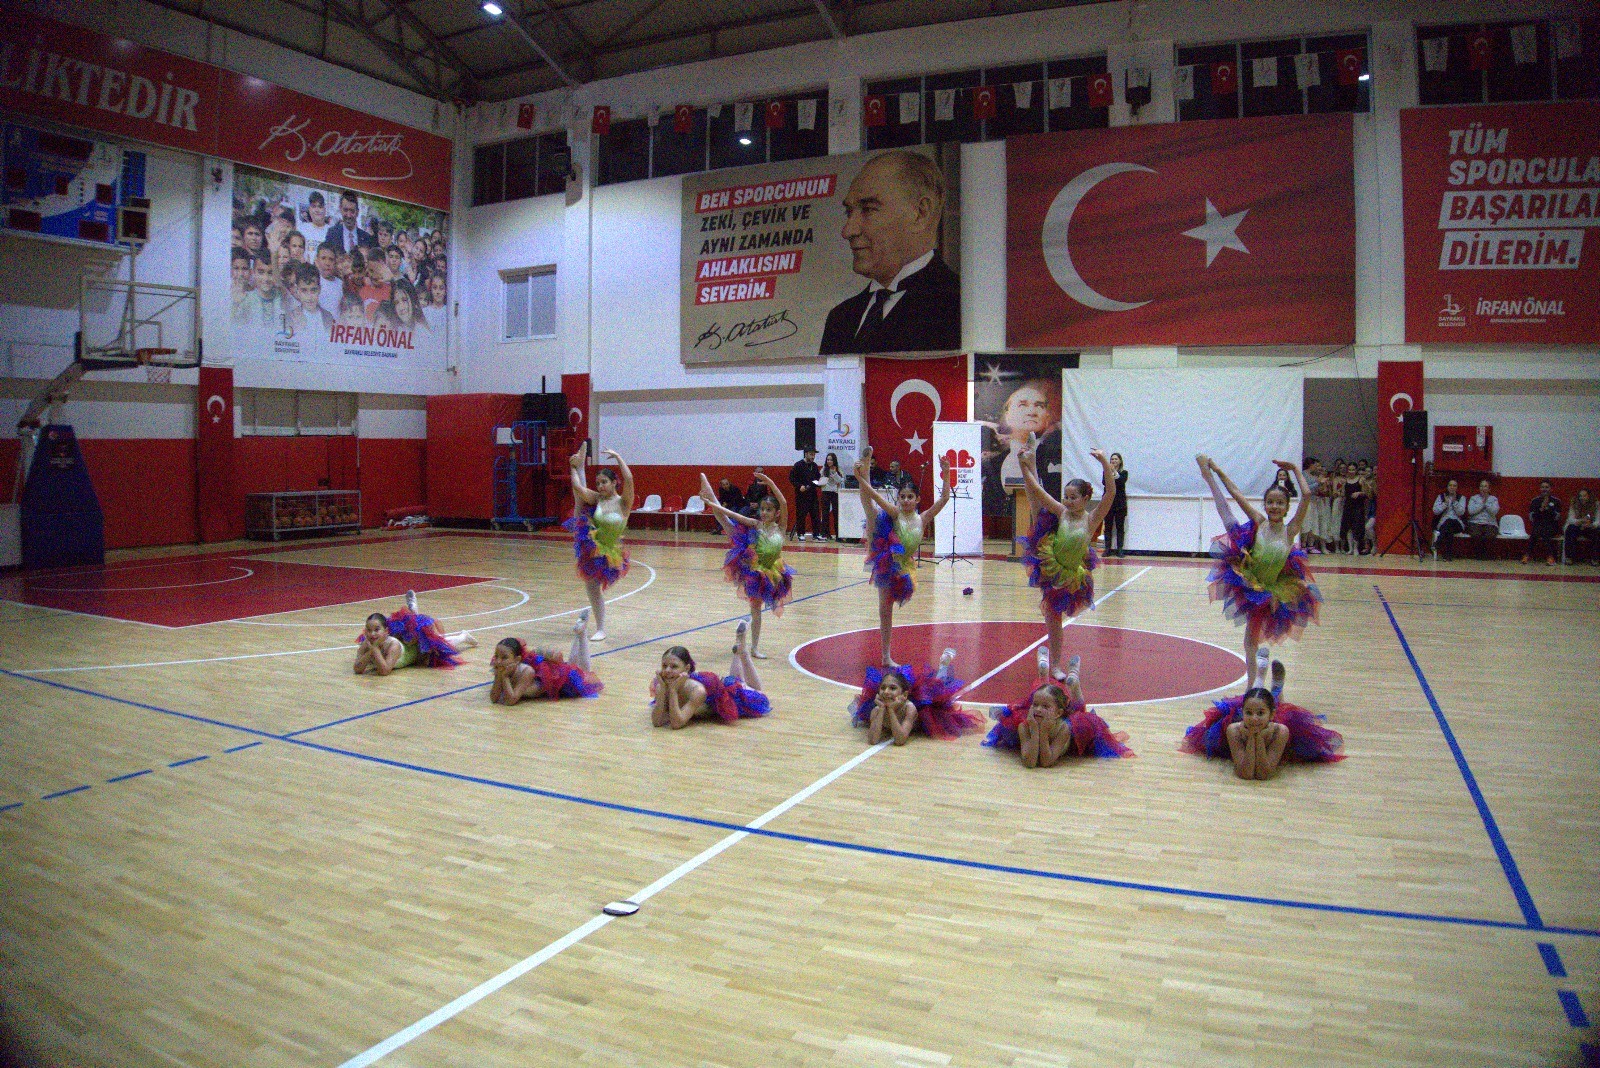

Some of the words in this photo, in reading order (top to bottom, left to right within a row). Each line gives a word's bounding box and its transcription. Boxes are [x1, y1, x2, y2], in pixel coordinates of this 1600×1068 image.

[1448, 121, 1509, 155] TÜM
[699, 190, 730, 210] BEN
[733, 178, 831, 205] SPORCUNUN
[700, 210, 736, 233] ZEKİ,
[741, 204, 788, 230] ÇEVİK
[791, 204, 812, 221] VE
[700, 236, 736, 255] AYNI
[738, 227, 814, 251] ZAMANDA
[1448, 232, 1576, 265] DİLERİM.
[699, 253, 797, 279] AHLAKLISINI
[700, 278, 771, 303] SEVERİM.
[1475, 297, 1522, 316] İRFAN
[1523, 296, 1566, 316] ÖNAL
[330, 319, 375, 347] İRFAN
[376, 325, 415, 350] ÖNAL
